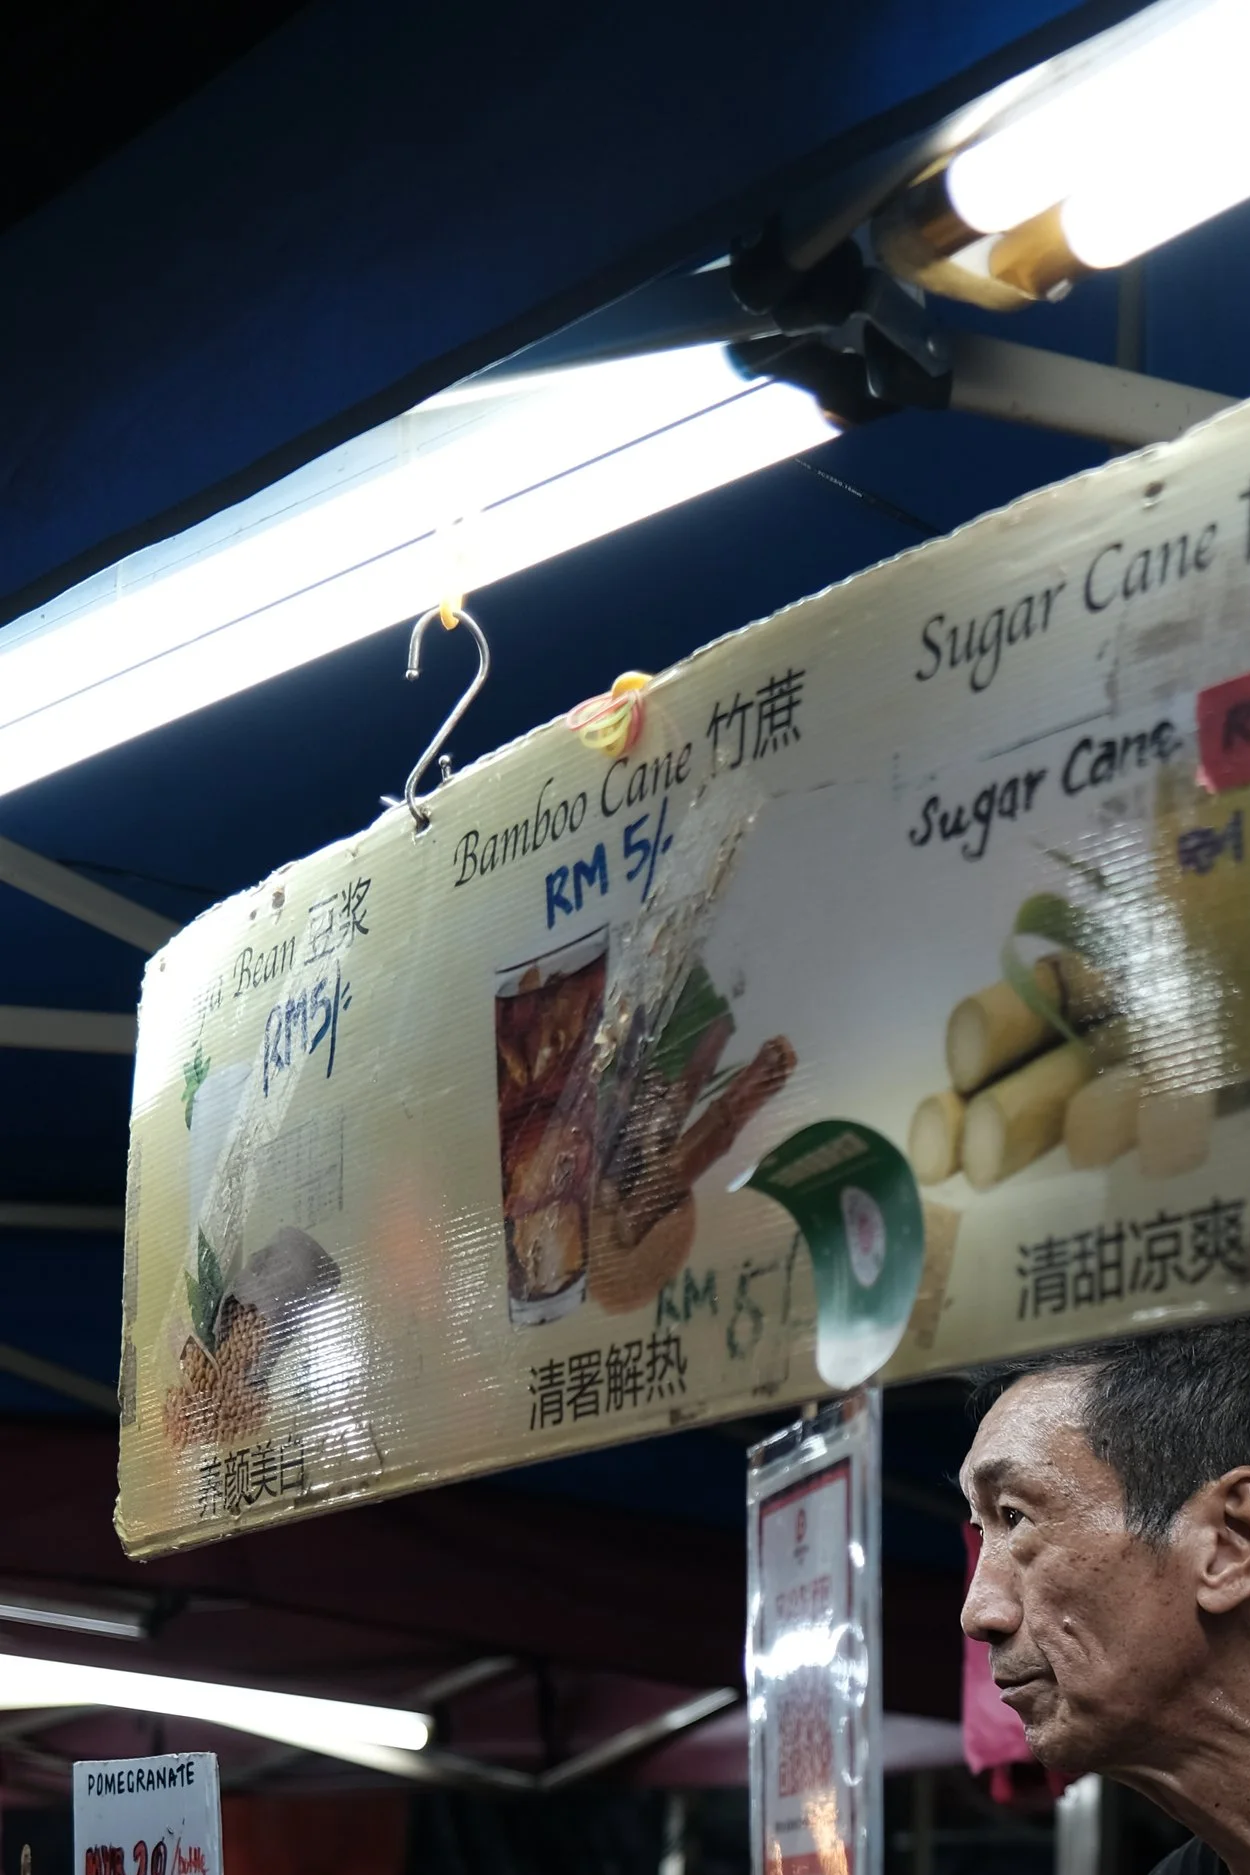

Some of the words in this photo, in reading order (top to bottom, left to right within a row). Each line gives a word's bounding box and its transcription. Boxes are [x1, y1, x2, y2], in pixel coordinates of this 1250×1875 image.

[916, 580, 1067, 693] Sugar
[1084, 522, 1218, 613] Cane
[706, 669, 806, 778] 竹蔗
[453, 777, 588, 888] Bamboo
[600, 742, 693, 818] Cane
[908, 770, 1048, 863] Sugar
[1062, 720, 1184, 797] Cane
[303, 876, 372, 967] 豆浆
[545, 843, 609, 930] RM
[232, 935, 296, 998] Bean
[1016, 1197, 1250, 1321] 清甜凉爽
[87, 1761, 195, 1796] POMEGRANATE
